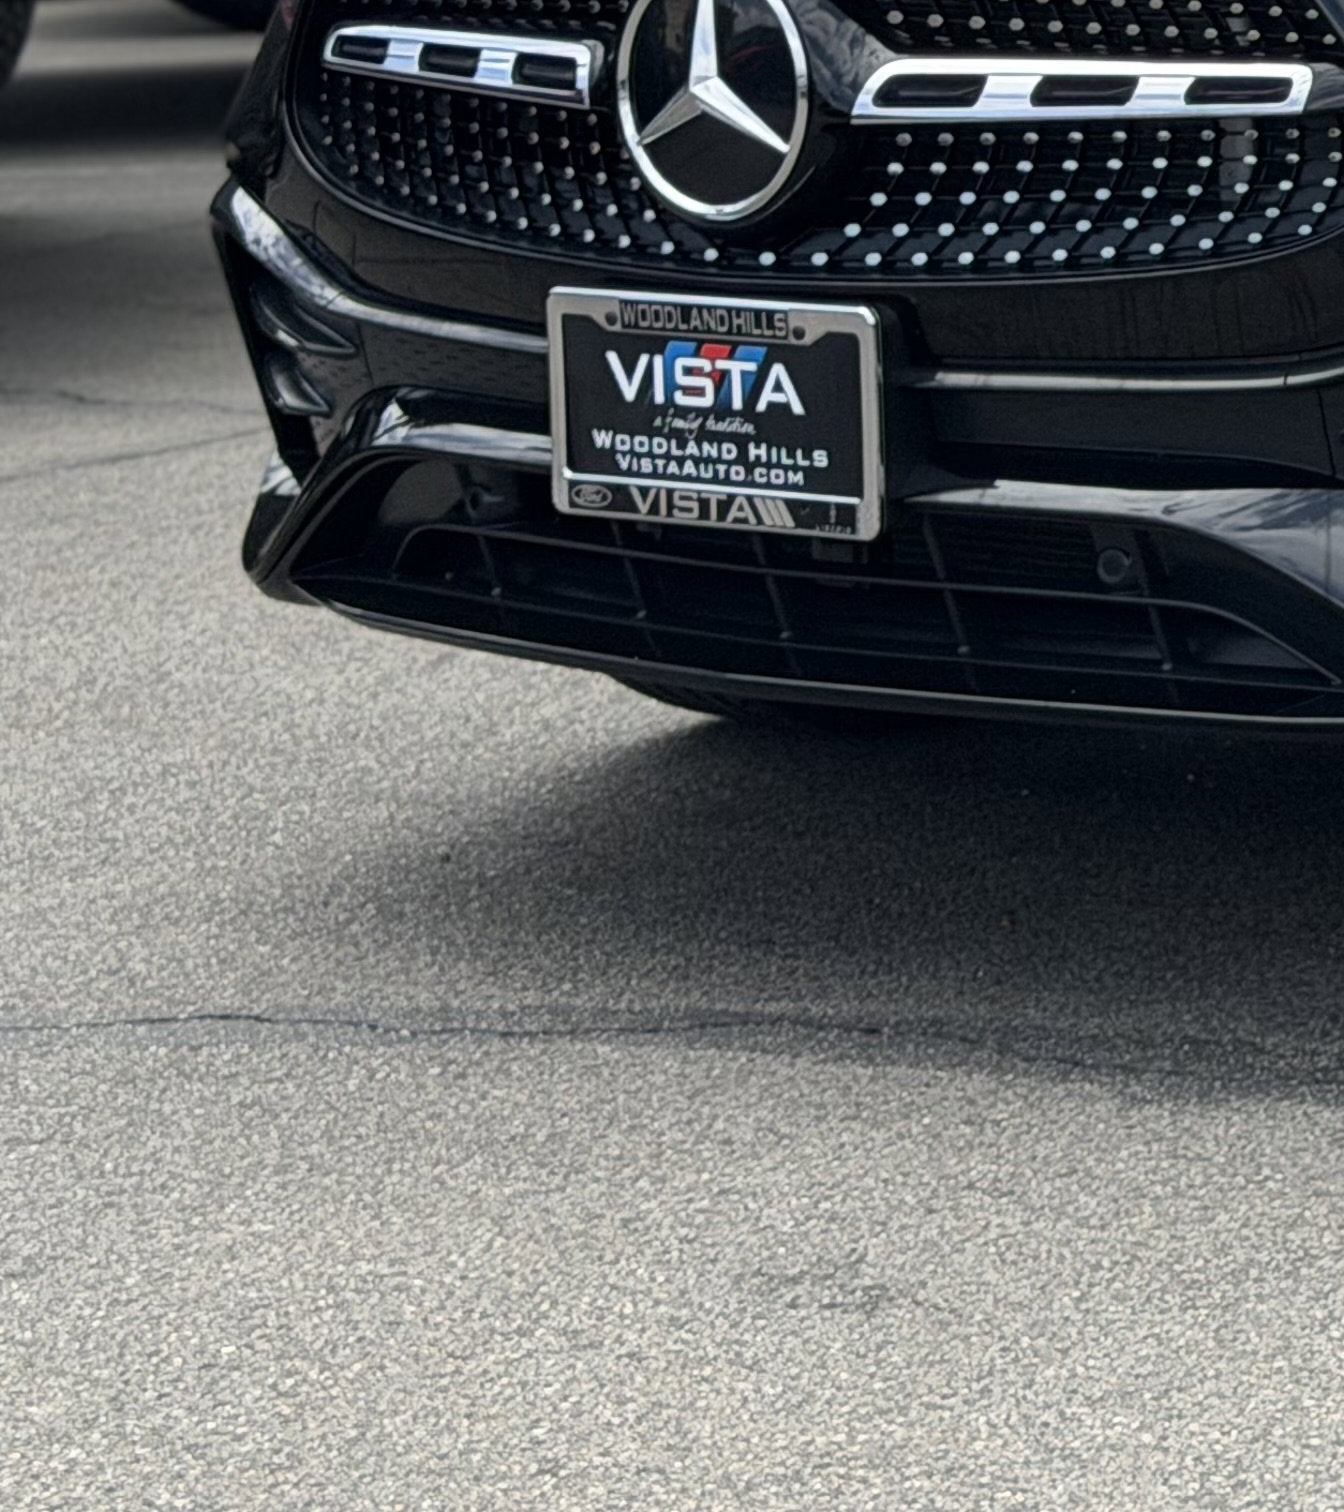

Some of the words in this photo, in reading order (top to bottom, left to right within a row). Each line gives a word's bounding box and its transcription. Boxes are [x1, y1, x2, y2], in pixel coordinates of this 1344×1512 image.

[621, 302, 730, 334] WOODLAND
[731, 310, 788, 338] HILLS
[605, 350, 806, 416] VISTA
[628, 486, 758, 525] VISTA
